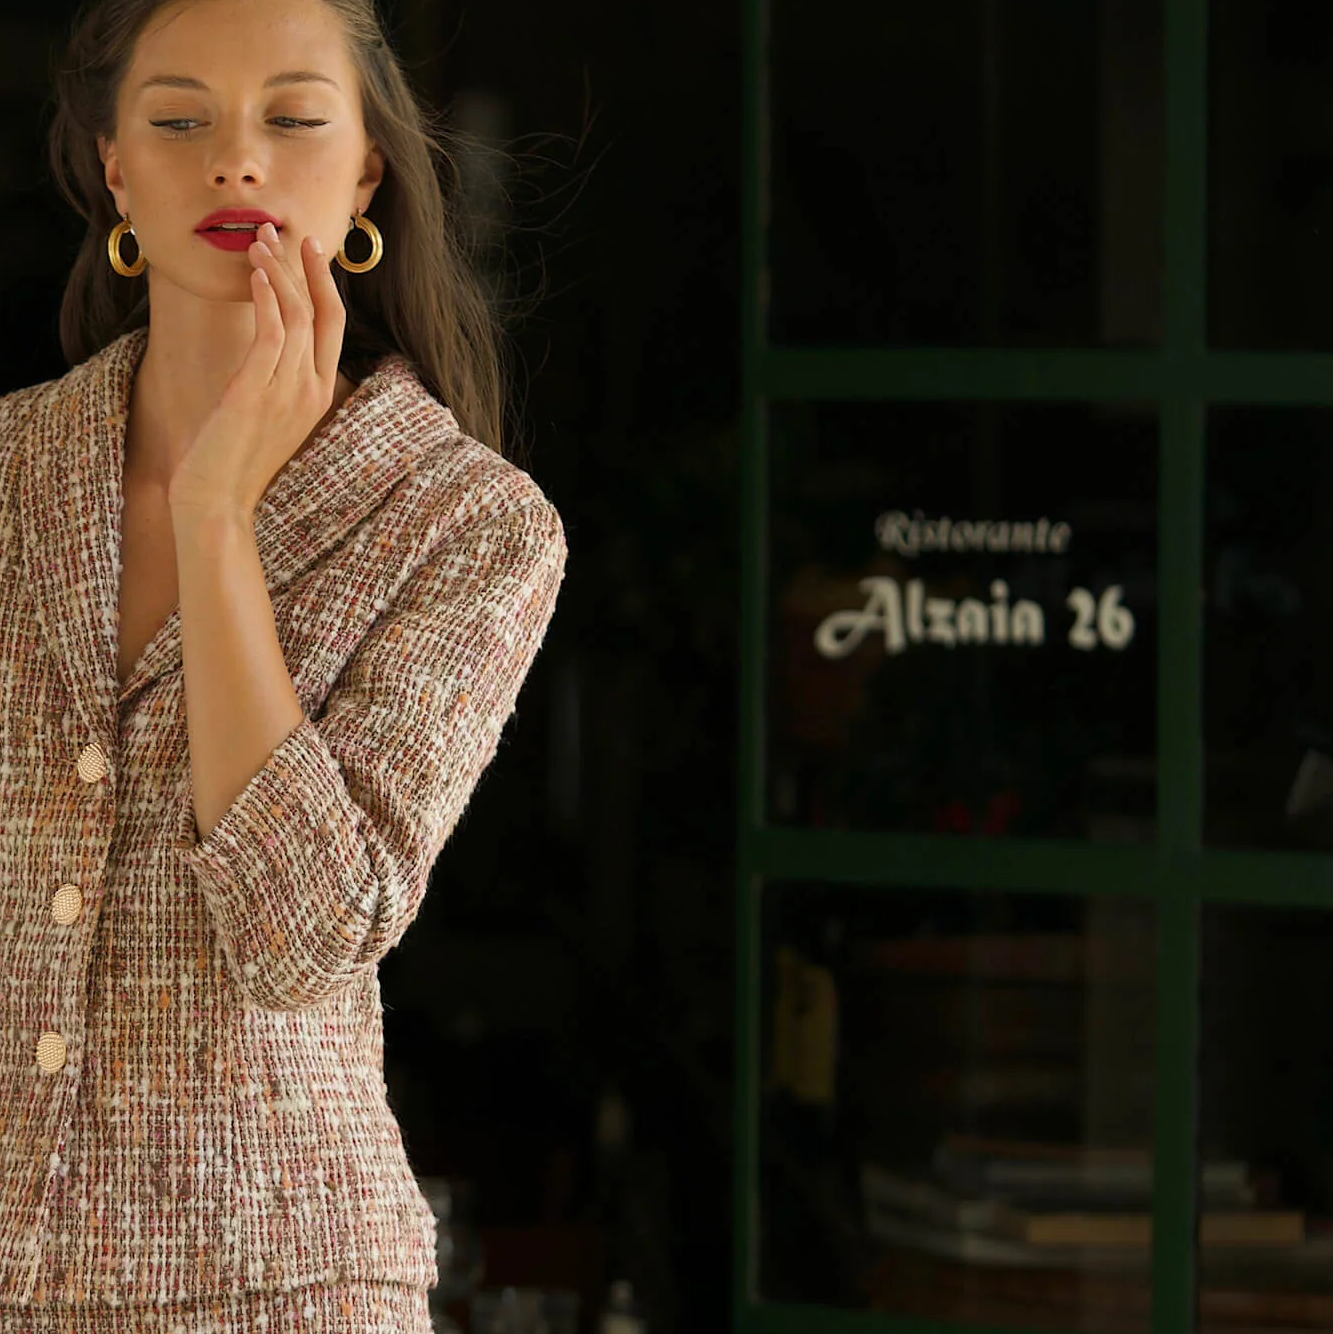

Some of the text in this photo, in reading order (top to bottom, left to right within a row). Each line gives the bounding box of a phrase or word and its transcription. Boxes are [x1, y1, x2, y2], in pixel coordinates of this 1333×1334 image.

[875, 510, 1072, 556] Ristorante
[813, 575, 1136, 659] Alzaia 26
